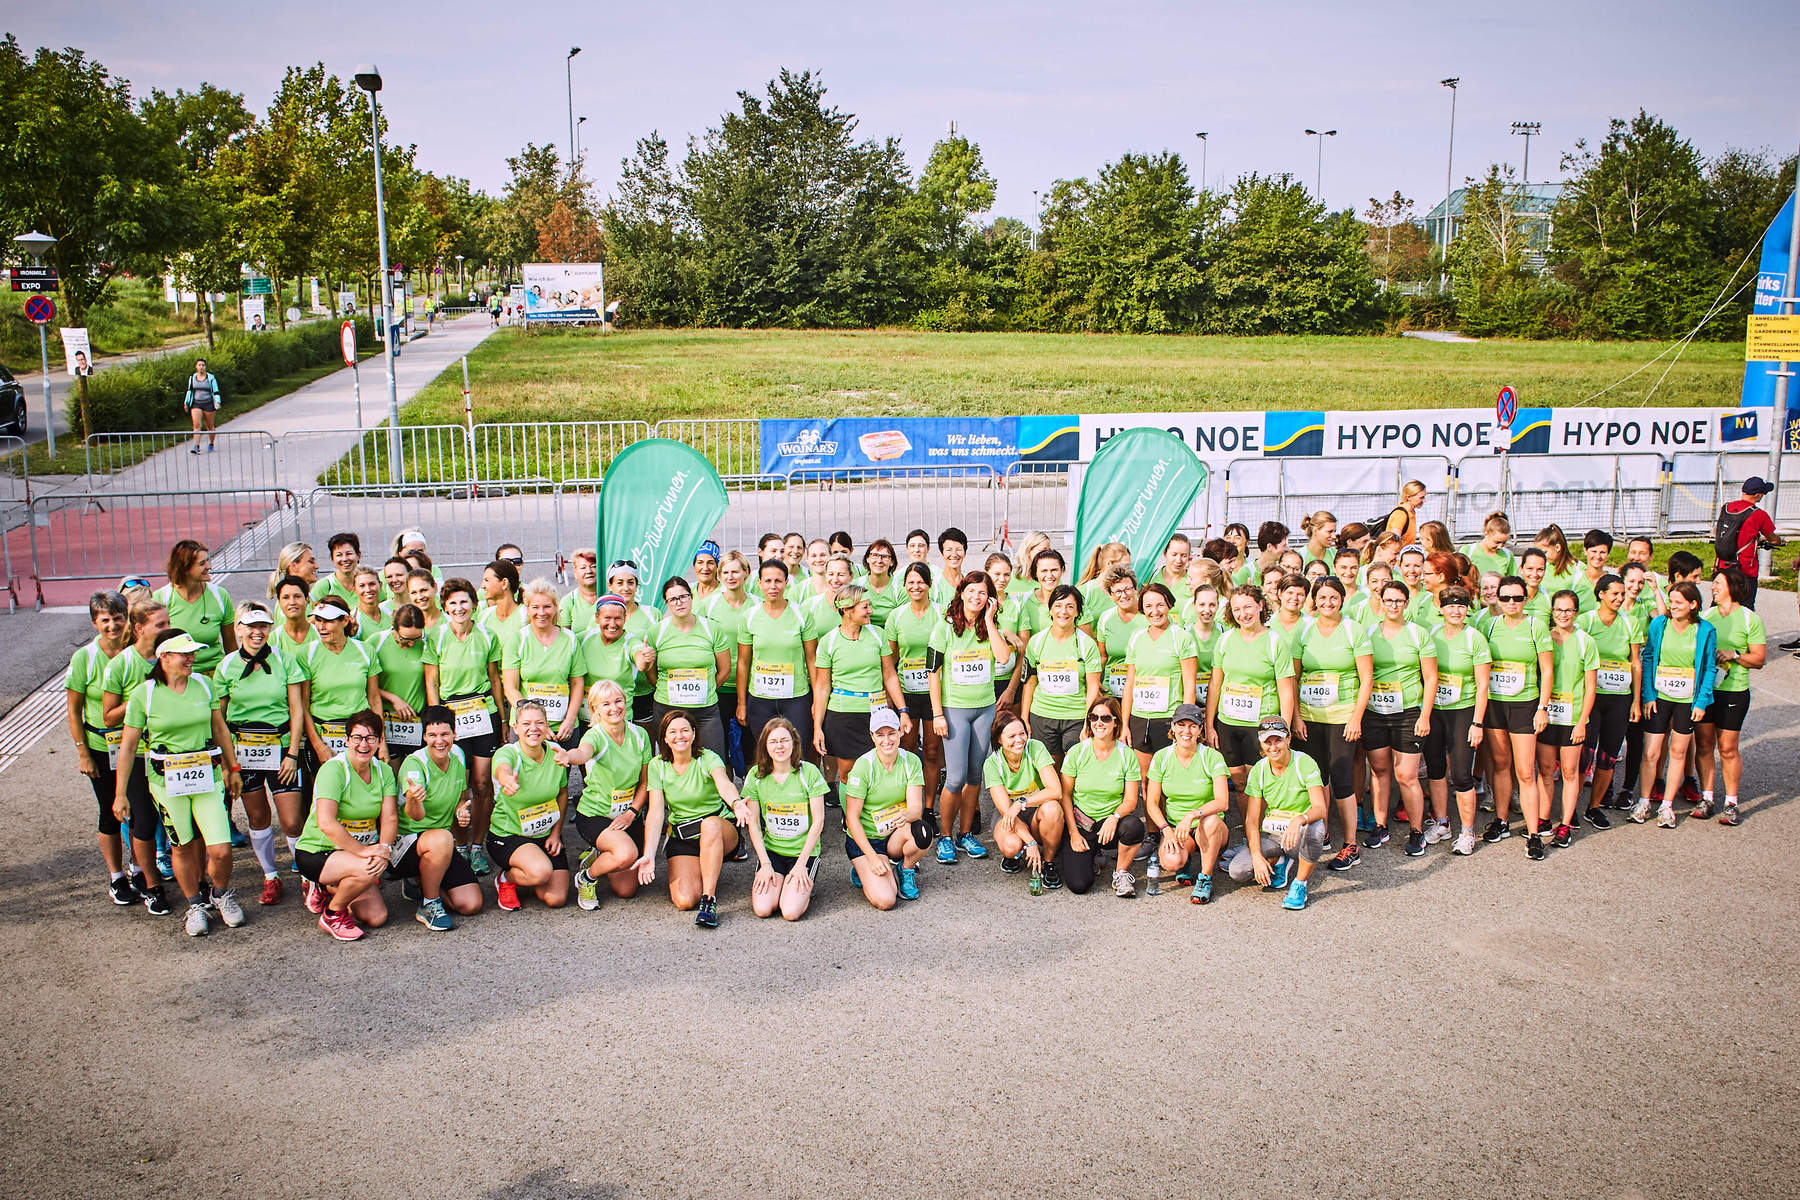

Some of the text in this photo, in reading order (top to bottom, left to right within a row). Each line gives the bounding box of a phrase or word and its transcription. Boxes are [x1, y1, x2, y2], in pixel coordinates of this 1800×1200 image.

[21, 282, 41, 290] EXPO
[1735, 416, 1756, 429] NV
[1338, 422, 1492, 450] HYPO NOE
[1563, 420, 1708, 446] HYPO NOE
[947, 434, 1002, 448] Wir lieben,
[1196, 426, 1259, 452] NOE
[782, 443, 834, 455] WOJNAR'S
[928, 443, 1020, 457] was uns schmeckt.
[961, 663, 984, 673] 1360
[911, 671, 929, 680] 133
[1047, 674, 1071, 682] 1398
[1495, 674, 1517, 683] 1339
[1604, 673, 1625, 682] 1438
[762, 676, 785, 686] 1371
[1664, 679, 1686, 688] 1429
[676, 683, 701, 692] 1406
[1308, 687, 1330, 696] 1408
[1437, 686, 1452, 696] 334
[1139, 690, 1161, 700] 1362
[1372, 694, 1395, 703] 1363
[543, 699, 562, 708] 386
[1230, 698, 1253, 709] 1333
[1547, 704, 1564, 713] 328
[456, 714, 482, 726] 1355
[244, 748, 272, 757] 1335
[176, 769, 205, 781] 1426
[530, 817, 553, 831] 1384
[774, 817, 800, 826] 1358
[353, 834, 371, 845] 349
